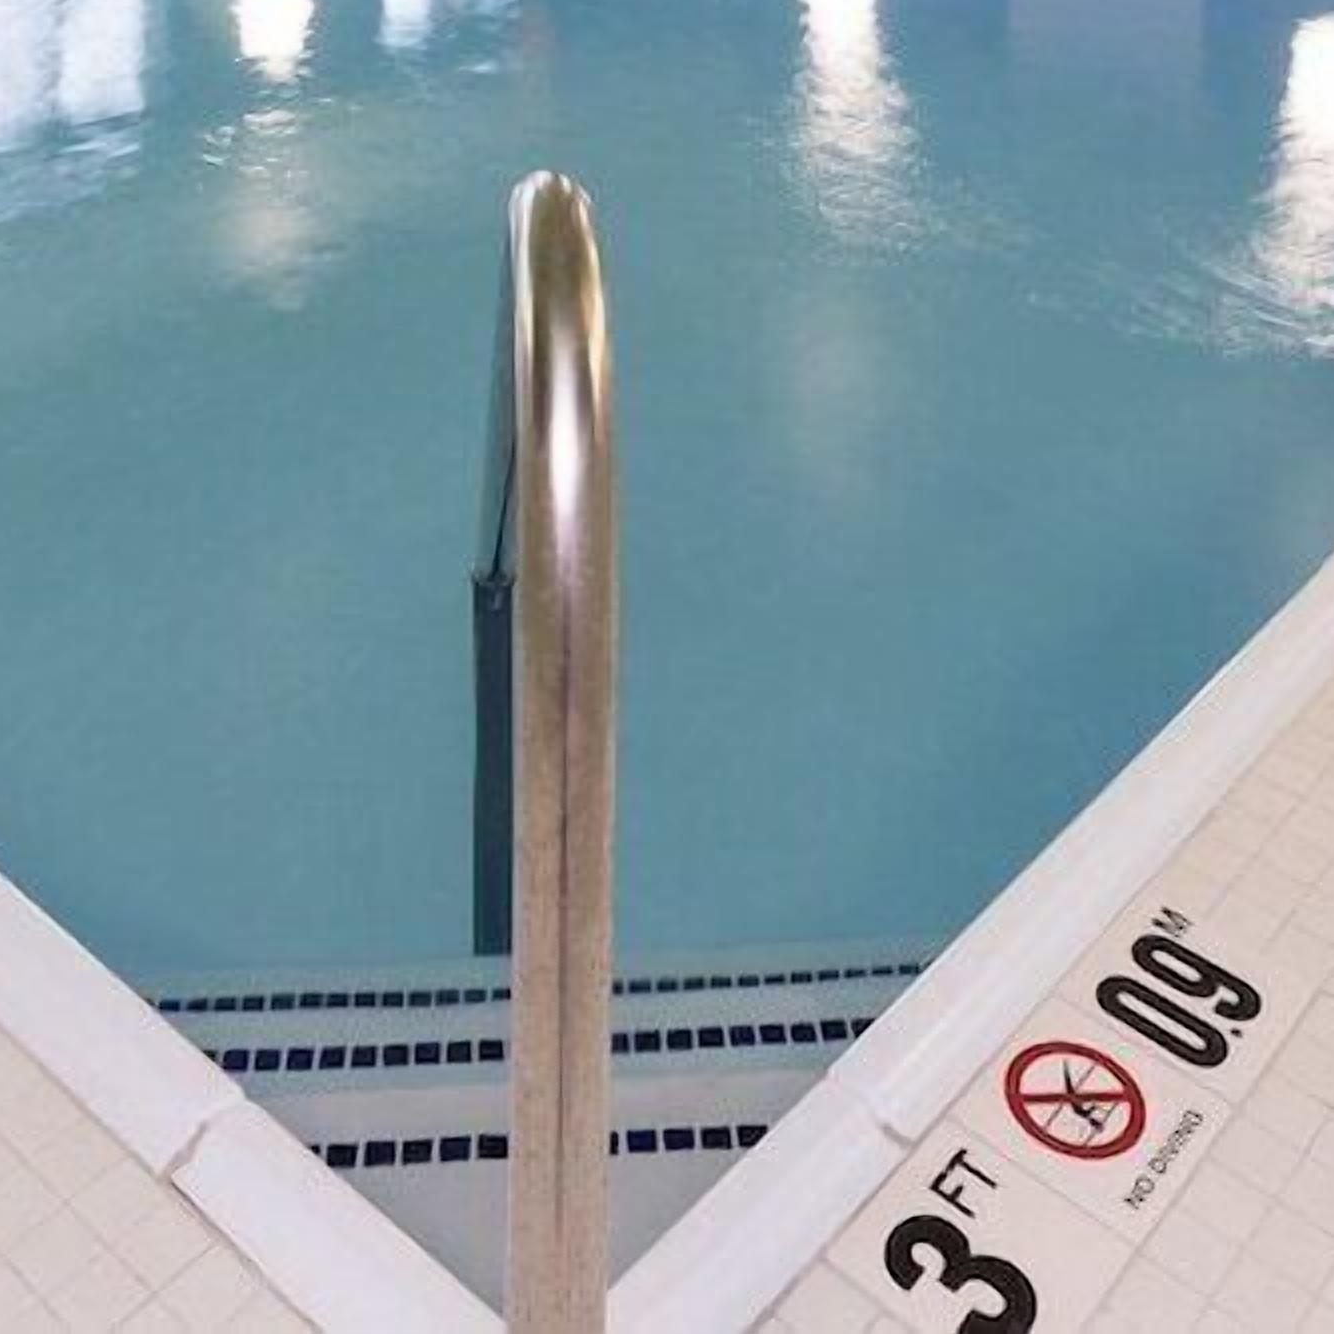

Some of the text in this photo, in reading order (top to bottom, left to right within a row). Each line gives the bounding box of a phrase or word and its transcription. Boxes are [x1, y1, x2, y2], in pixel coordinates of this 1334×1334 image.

[1095, 933, 1263, 1068] 0.9
[884, 1148, 1038, 1334] 3 FT
[1123, 1176, 1155, 1210] NO
